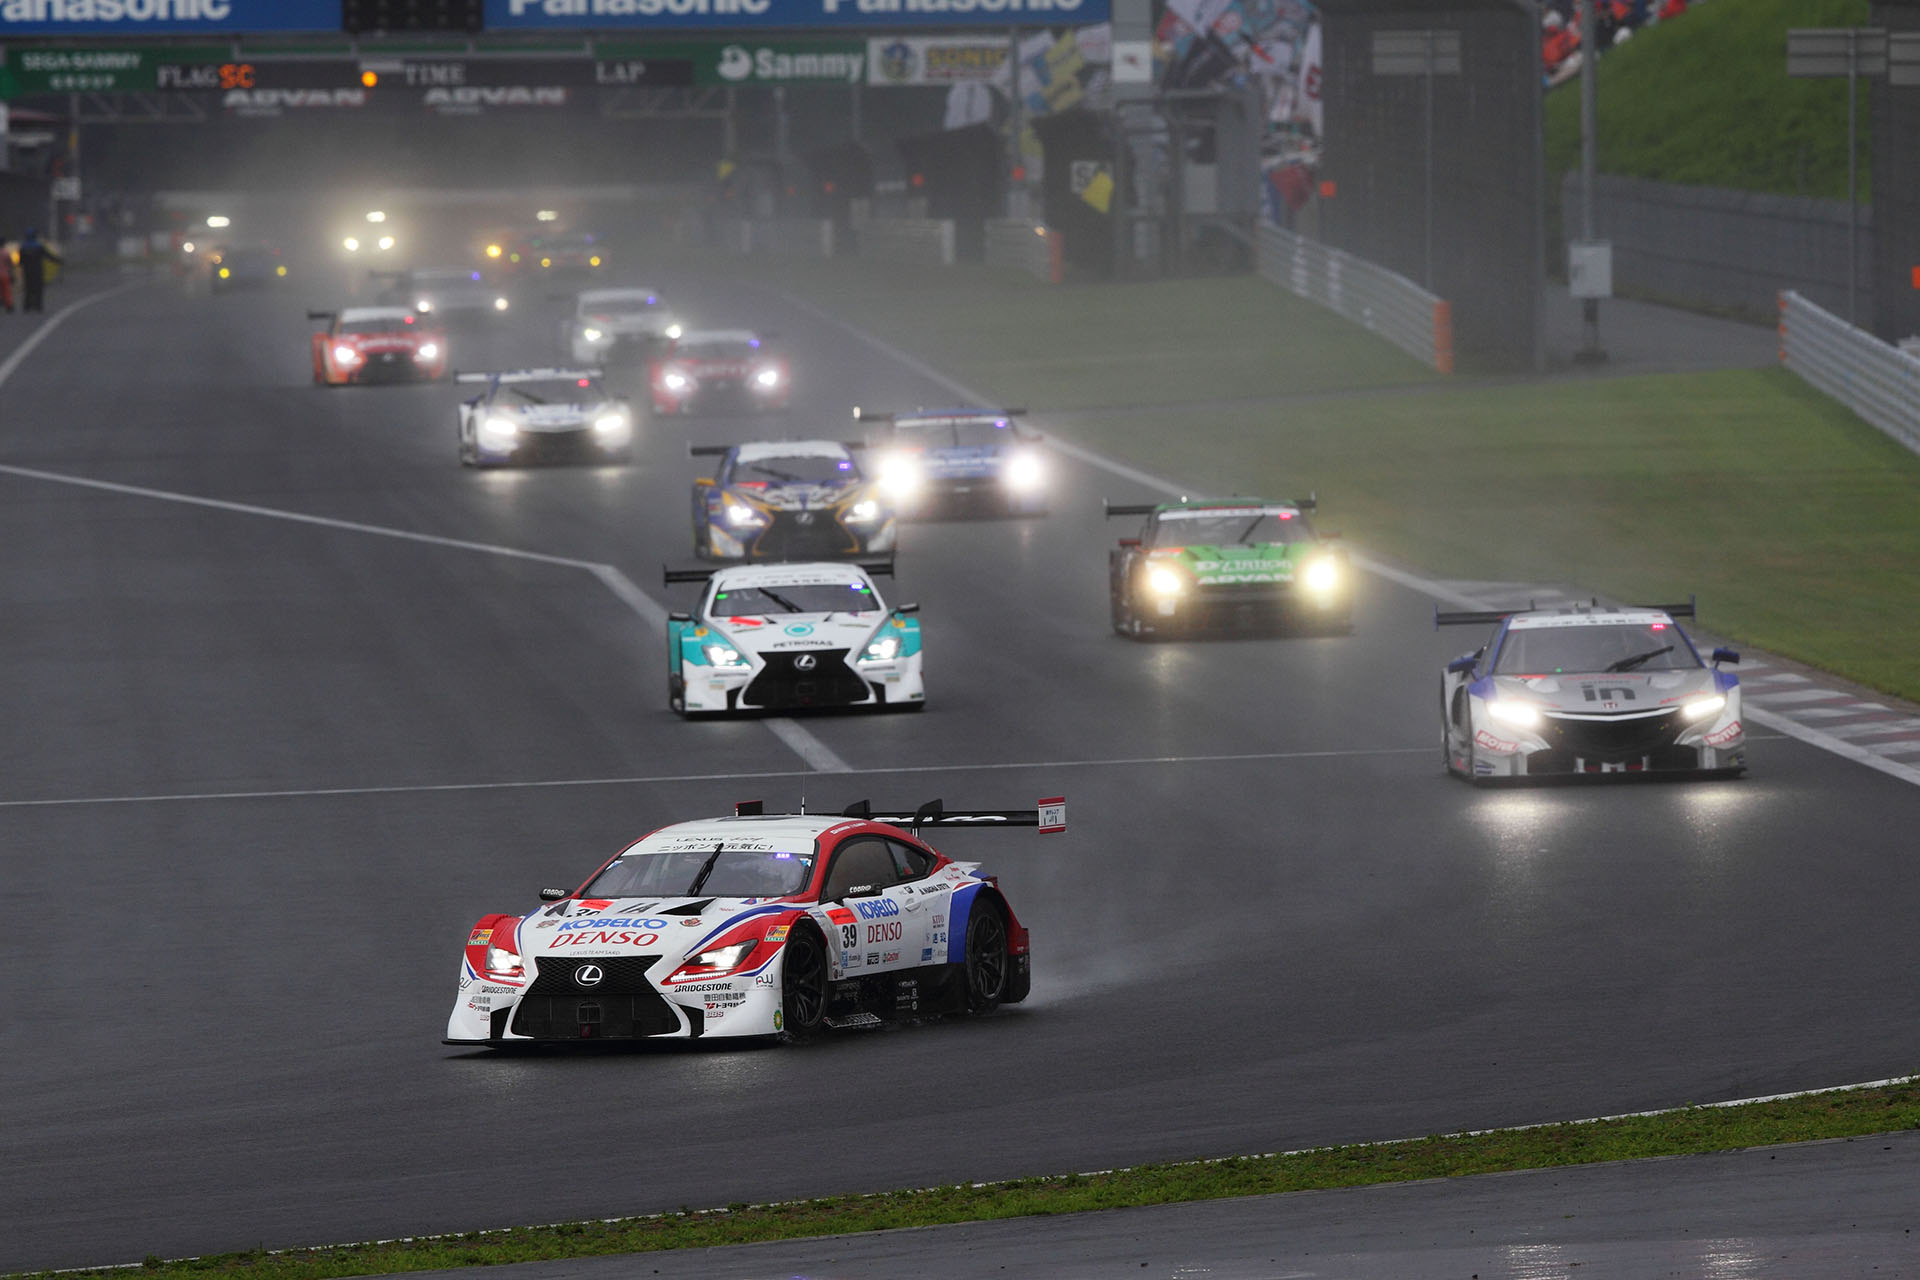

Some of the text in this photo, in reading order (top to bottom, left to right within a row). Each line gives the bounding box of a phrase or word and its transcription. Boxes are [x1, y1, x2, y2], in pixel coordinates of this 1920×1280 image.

[596, 61, 645, 83] LAP
[755, 48, 864, 81] Sammy
[156, 64, 254, 88] FLAG SC
[405, 63, 464, 85] TIME
[225, 88, 364, 105] ADVAN
[425, 86, 565, 104] ADVAN
[773, 640, 834, 649] PETRONAS
[1580, 684, 1636, 702] in
[855, 898, 899, 920] KOBELCO
[558, 918, 668, 931] KOBELCO
[867, 921, 902, 944] DENSO
[549, 931, 659, 949] DENSO
[842, 924, 857, 949] 39
[481, 985, 517, 994] BRIDGESTONE
[674, 983, 732, 992] BRIDGESTONE
